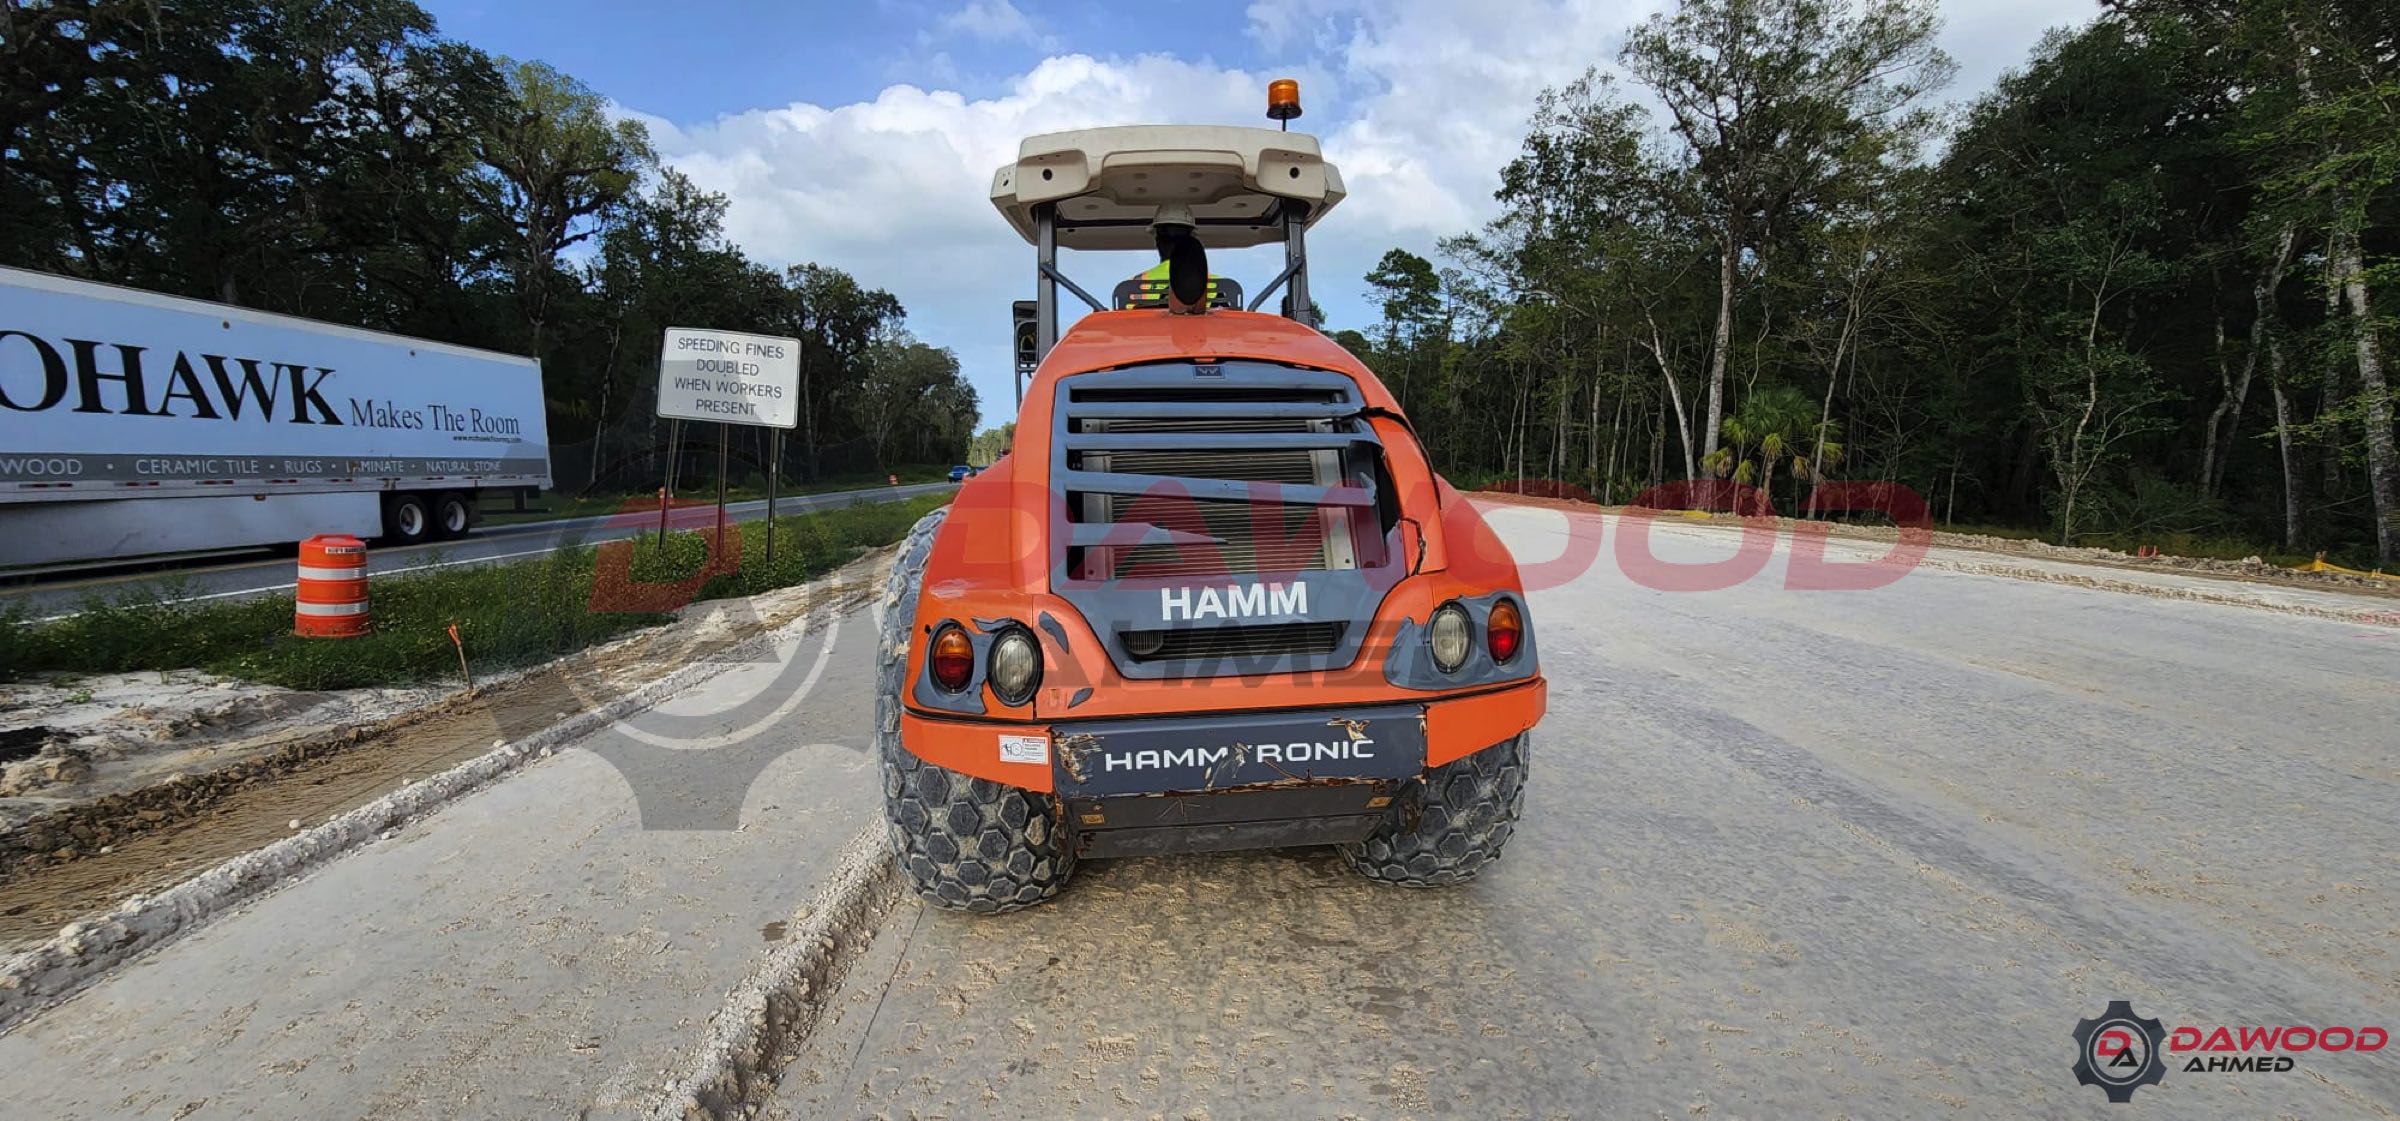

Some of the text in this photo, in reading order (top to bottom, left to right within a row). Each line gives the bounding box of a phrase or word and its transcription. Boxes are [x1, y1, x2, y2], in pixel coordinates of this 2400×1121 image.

[677, 337, 785, 360] SPEEDING FINES
[696, 359, 760, 376] DOUBLED
[674, 377, 782, 399] WHEN WORKERS
[349, 398, 424, 431] Makes
[427, 404, 465, 432] The
[470, 408, 521, 435] Room
[695, 399, 757, 416] PRESENT
[135, 459, 219, 474] CERAMIC
[225, 460, 260, 474] TILE
[284, 460, 323, 474] RUGS
[426, 461, 471, 473] NATURAL
[474, 460, 502, 473] STONE
[1161, 581, 1308, 622] HAMM
[1105, 739, 1375, 772] HAMMRONIC
